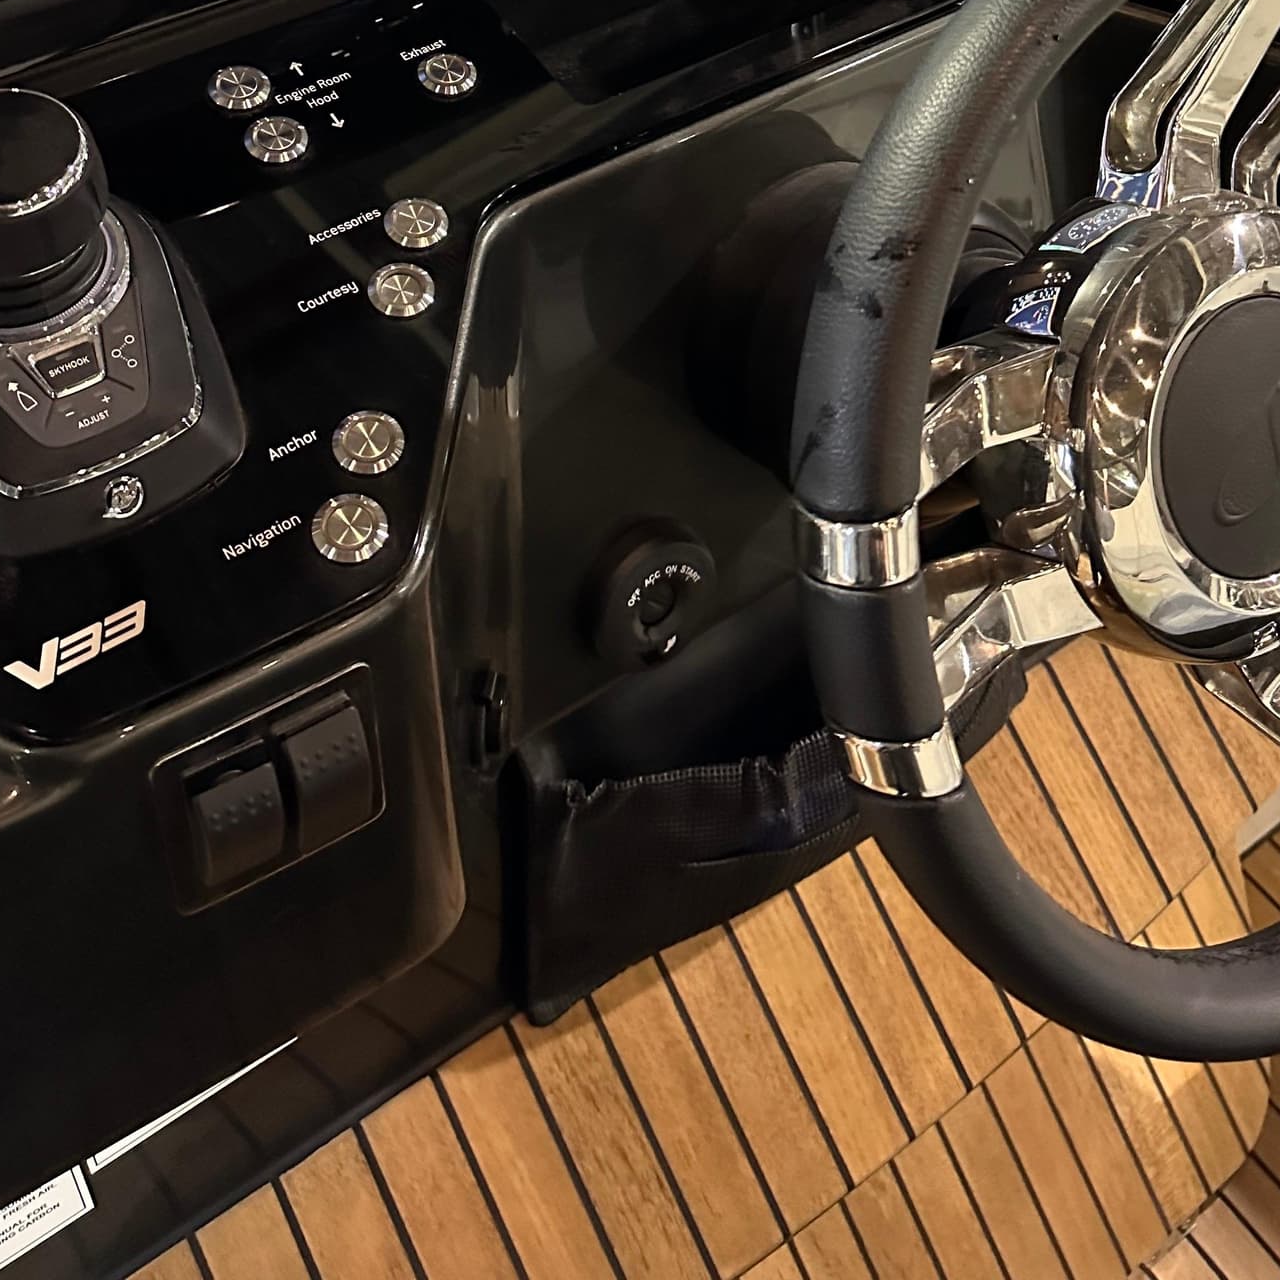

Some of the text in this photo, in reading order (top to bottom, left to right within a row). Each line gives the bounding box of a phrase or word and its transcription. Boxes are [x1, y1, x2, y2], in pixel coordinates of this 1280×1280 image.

[399, 39, 447, 62] Exhaust
[275, 70, 352, 106] Engine Room
[306, 90, 340, 110] Hood
[308, 208, 382, 246] Accessories
[297, 280, 360, 313] Courtesy
[48, 355, 91, 379] SKYHOOK
[77, 409, 111, 430] ADJUST
[268, 429, 318, 462] Anchor
[222, 514, 302, 561] Navigation
[627, 564, 702, 607] OFF ACC ON START
[3, 599, 147, 690] V33
[2, 1195, 36, 1220] FRESH
[18, 1202, 60, 1232] CARBON
[26, 1203, 47, 1219] FOR
